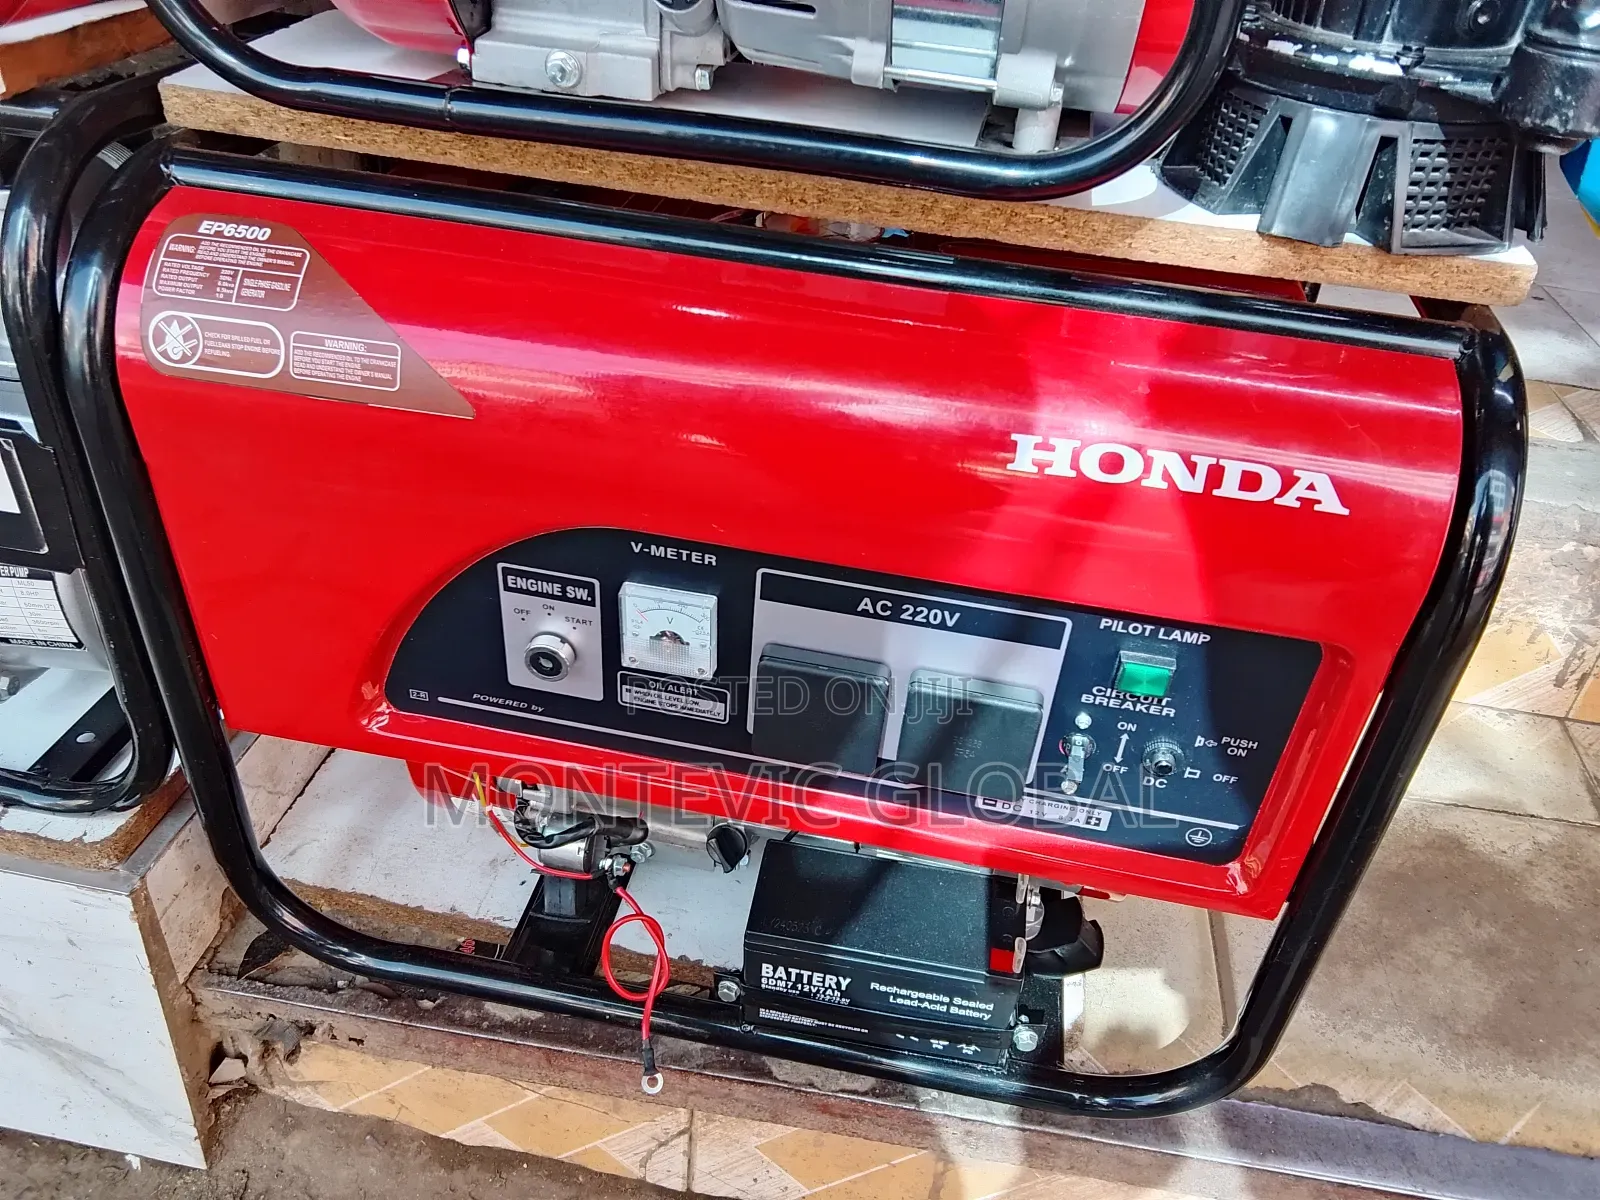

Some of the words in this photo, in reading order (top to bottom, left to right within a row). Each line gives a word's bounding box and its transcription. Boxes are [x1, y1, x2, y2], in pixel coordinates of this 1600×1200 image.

[198, 220, 271, 241] EP6500
[169, 243, 197, 254] WARNING:
[162, 267, 179, 275] RATED
[180, 269, 210, 278] FREQUENCY
[164, 261, 181, 269] RATED
[181, 263, 205, 271] VOLTAGE
[159, 279, 183, 288] MAXIMUM
[183, 282, 204, 290] OUTPUT
[161, 273, 177, 281] RATED
[178, 275, 199, 283] OUTPUT
[157, 285, 176, 293] POWER
[176, 287, 196, 296] FACTOR
[204, 331, 221, 339] CHECK
[231, 334, 251, 343] SPILLED
[250, 336, 263, 344] FUEL
[231, 343, 244, 351] STOP
[244, 345, 262, 353] ENGINE
[262, 347, 281, 356] BEFORE
[324, 338, 368, 353] WARNING:
[1006, 433, 1350, 516] HONDA
[630, 541, 718, 567] V-METER
[9, 566, 29, 578] PUMP
[506, 575, 563, 596] ENGINE
[565, 585, 592, 602] SW.
[513, 607, 531, 616] OFF
[542, 603, 555, 611] ON
[856, 597, 893, 616] AC
[900, 603, 961, 627] 220V
[564, 616, 593, 626] START
[666, 616, 674, 625] V
[1099, 618, 1155, 637] PILOT
[1157, 626, 1212, 646] LAMP
[8, 638, 35, 646] MADE
[46, 641, 77, 649] CHINA
[648, 681, 665, 691] OIL
[667, 684, 699, 696] ALERT
[634, 689, 653, 699] WHEN
[664, 694, 684, 704] LEVEL
[1091, 685, 1172, 706] CIRCUIT
[472, 693, 528, 708] POWERED
[530, 704, 545, 713] by
[634, 696, 657, 705] ENGINE
[659, 700, 679, 709] STOPS
[1080, 694, 1176, 718] BREAKER
[1117, 721, 1138, 732] ON
[1221, 736, 1259, 750] PUSH
[1226, 746, 1248, 757] ON
[1102, 763, 1130, 775] OFF
[1142, 776, 1168, 789] DC
[1212, 773, 1239, 785] OFF
[1002, 802, 1023, 813] DC
[1029, 799, 1076, 812] CHARGING
[1079, 807, 1103, 817] ONLY
[1029, 809, 1048, 818] 12V
[761, 962, 852, 991] BATTERY
[761, 977, 794, 989] 6DM7
[796, 983, 841, 997] 12V7Ah
[761, 983, 788, 993] Standby
[870, 982, 951, 1004] Rechargeable
[953, 997, 994, 1011] Sealed
[889, 995, 947, 1012] Lead-Acid
[949, 1007, 992, 1021] Battery
